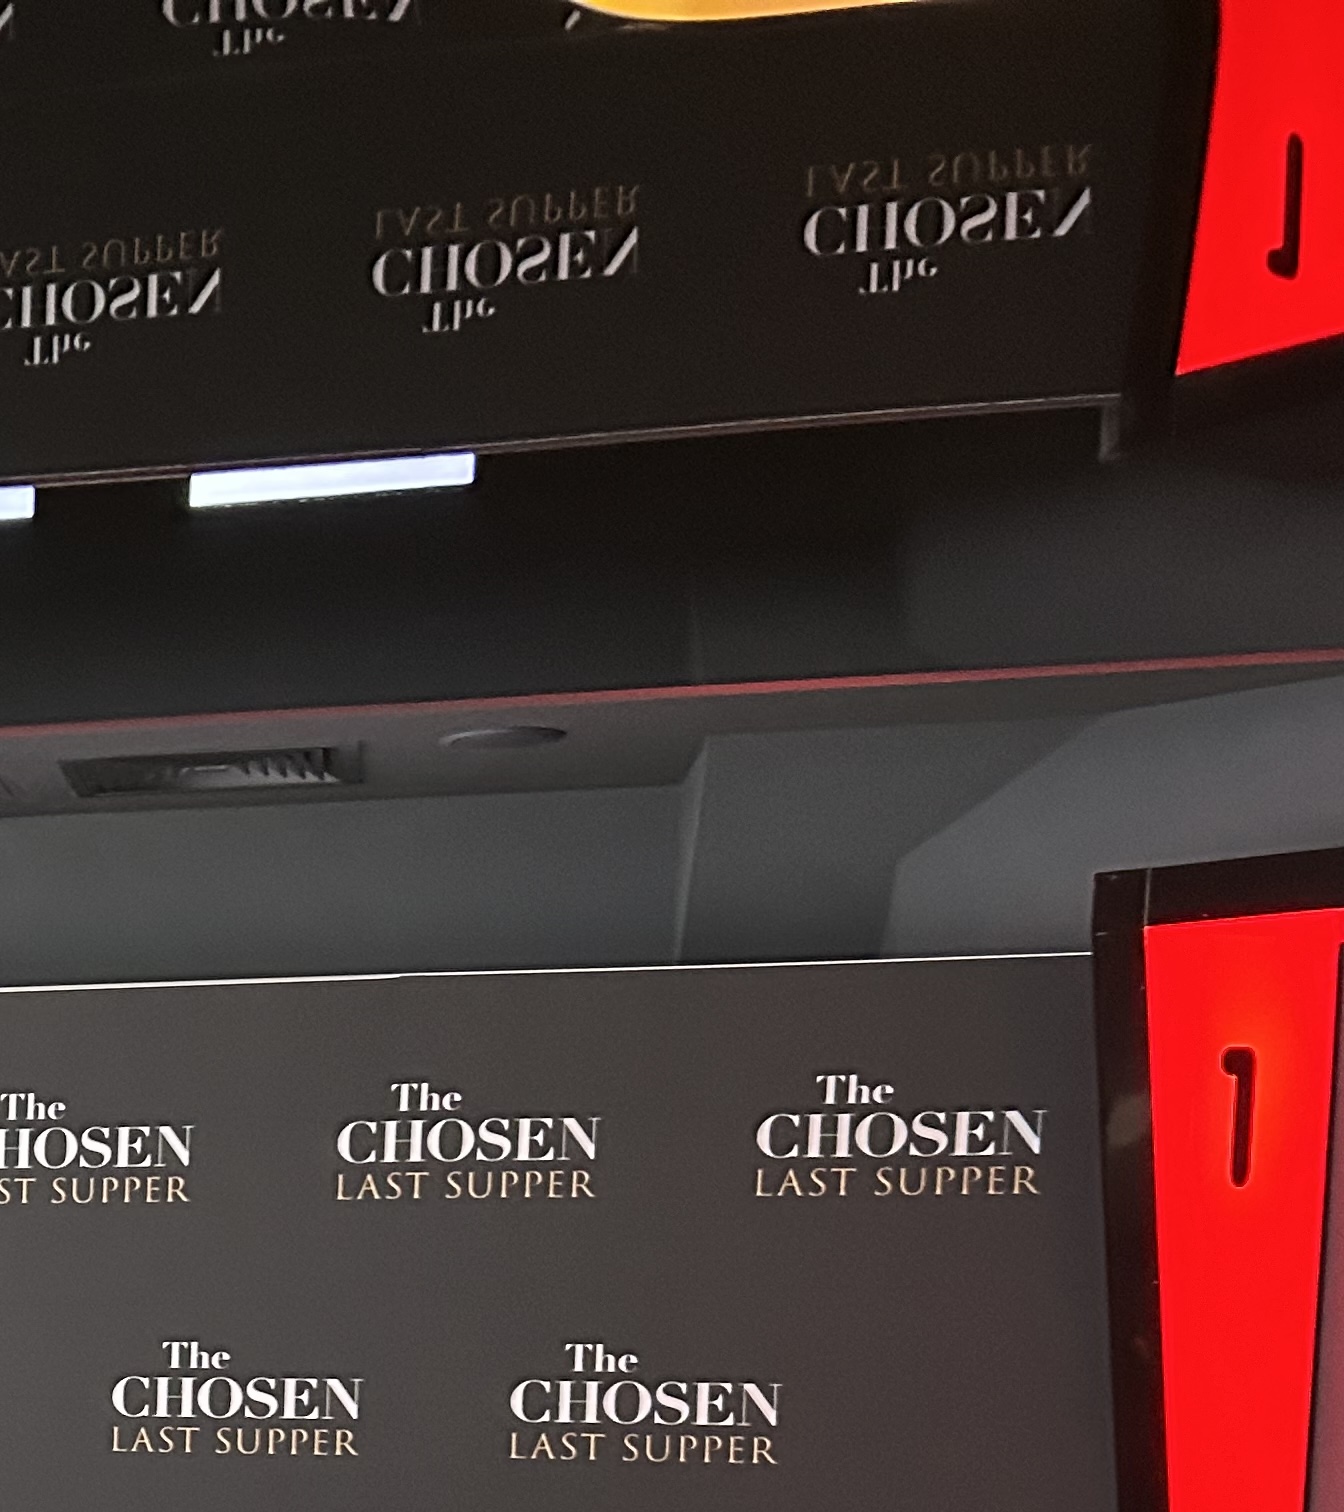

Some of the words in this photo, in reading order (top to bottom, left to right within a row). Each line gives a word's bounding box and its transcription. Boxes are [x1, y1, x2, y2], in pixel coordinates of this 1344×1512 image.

[391, 1083, 462, 1111] The
[816, 1075, 894, 1104] The
[0, 1093, 66, 1120] The
[337, 1118, 601, 1164] CHOSEN
[757, 1110, 1046, 1158] CHOSEN
[51, 1176, 189, 1203] SUPPER
[337, 1172, 429, 1200] LAST
[445, 1170, 594, 1198] SUPPER
[756, 1168, 857, 1196] LAST
[875, 1166, 1038, 1196] SUPPER
[162, 1342, 230, 1369] The
[565, 1344, 638, 1372] The
[112, 1376, 363, 1419] CHOSEN
[510, 1380, 782, 1426] CHOSEN
[113, 1426, 200, 1452] LAST
[215, 1428, 358, 1455] SUPPER
[510, 1433, 605, 1460] LAST
[623, 1434, 777, 1464] SUPPER
